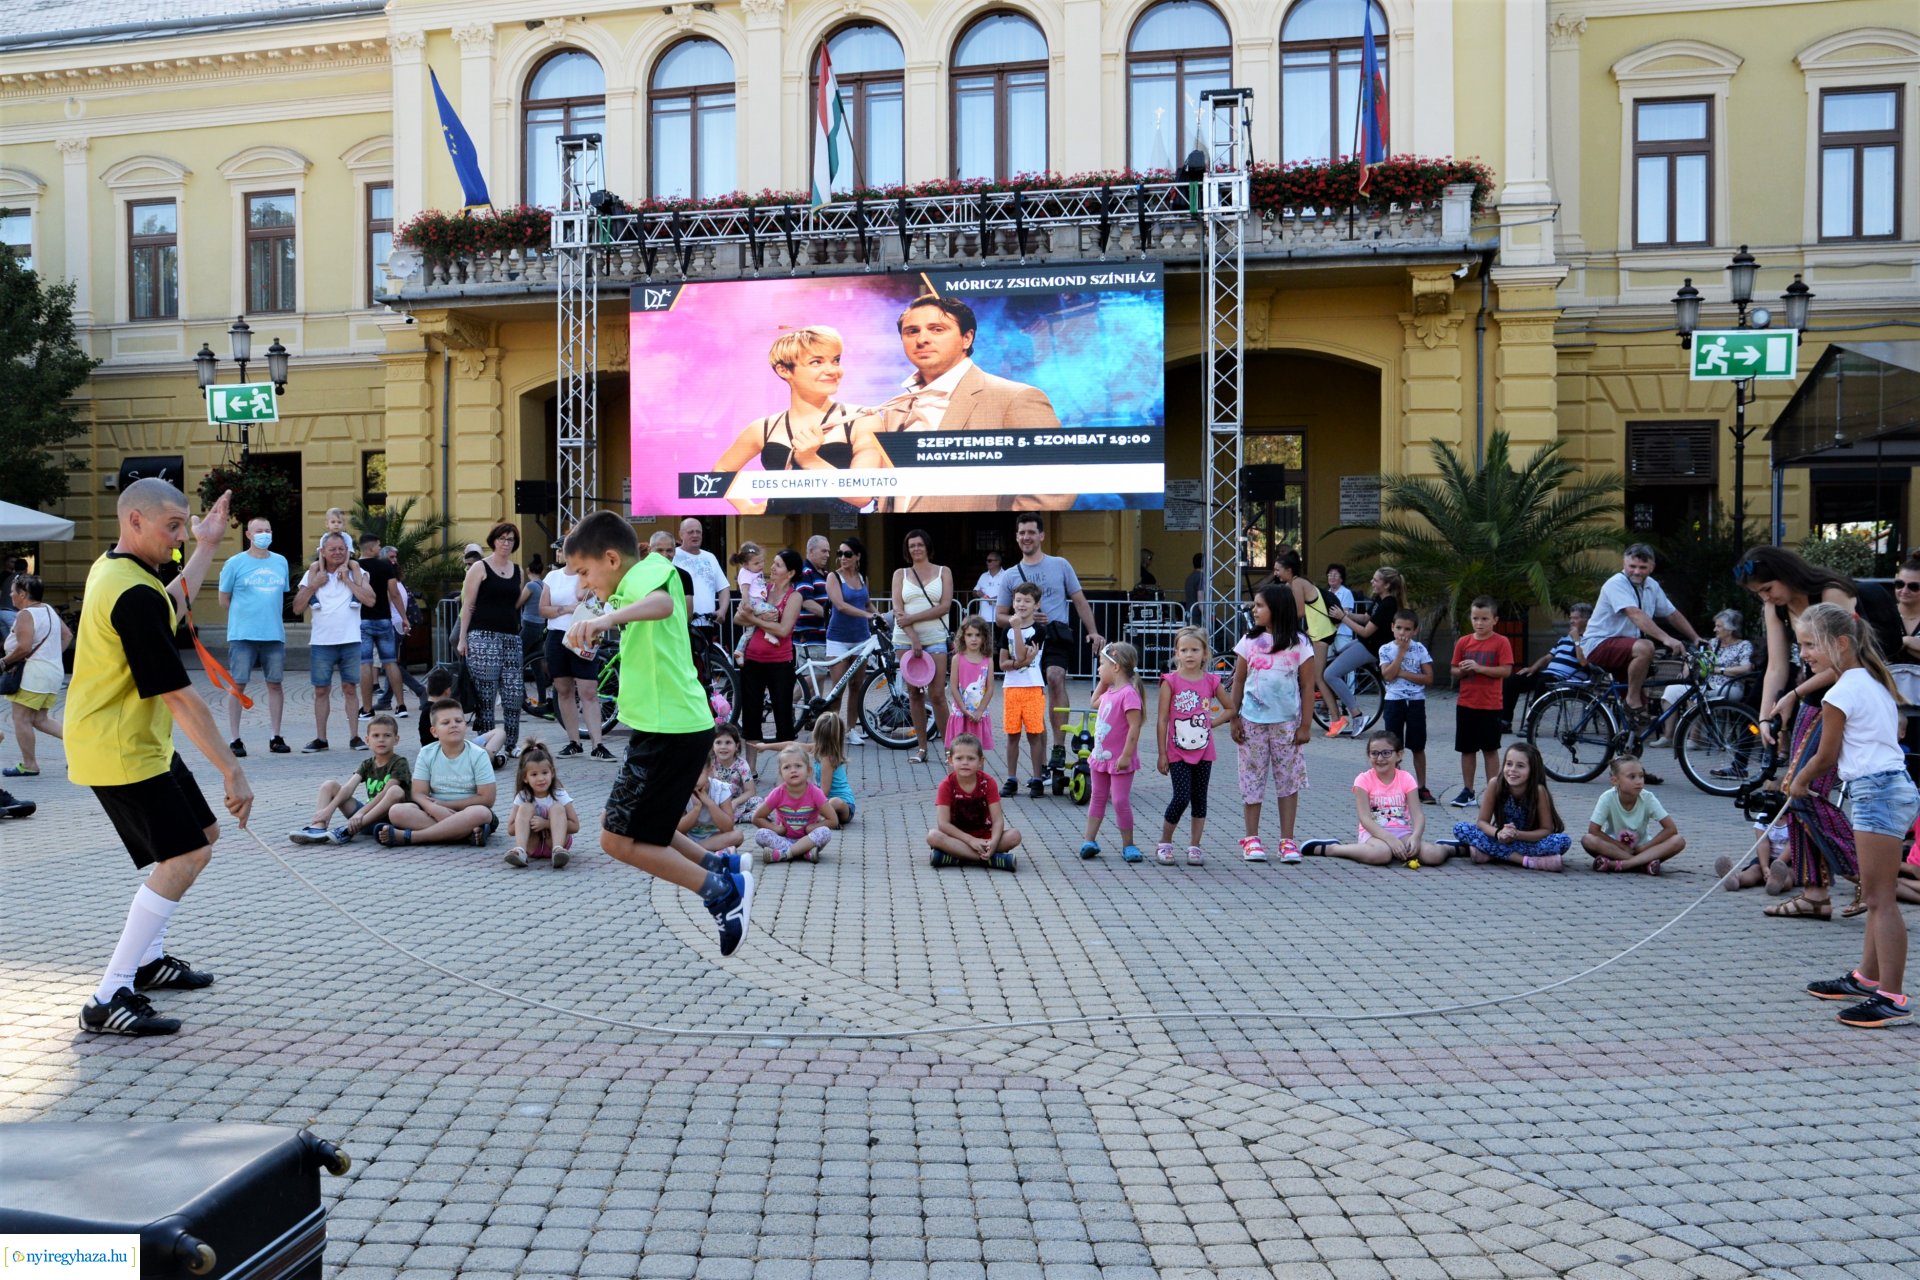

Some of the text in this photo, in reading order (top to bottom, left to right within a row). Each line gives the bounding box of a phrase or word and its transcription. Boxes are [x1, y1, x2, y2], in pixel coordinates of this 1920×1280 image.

[945, 271, 1156, 291] MÓRICZ ZSIGMOND SZÍNHÁZ
[917, 434, 1151, 448] SZEPTEMBER 5. SZOMBAT 19:00
[916, 450, 1003, 461] NAGYSZÍNPAD
[752, 479, 779, 489] EDES
[781, 479, 828, 488] CHARITY
[838, 477, 898, 488] BEMUTATO
